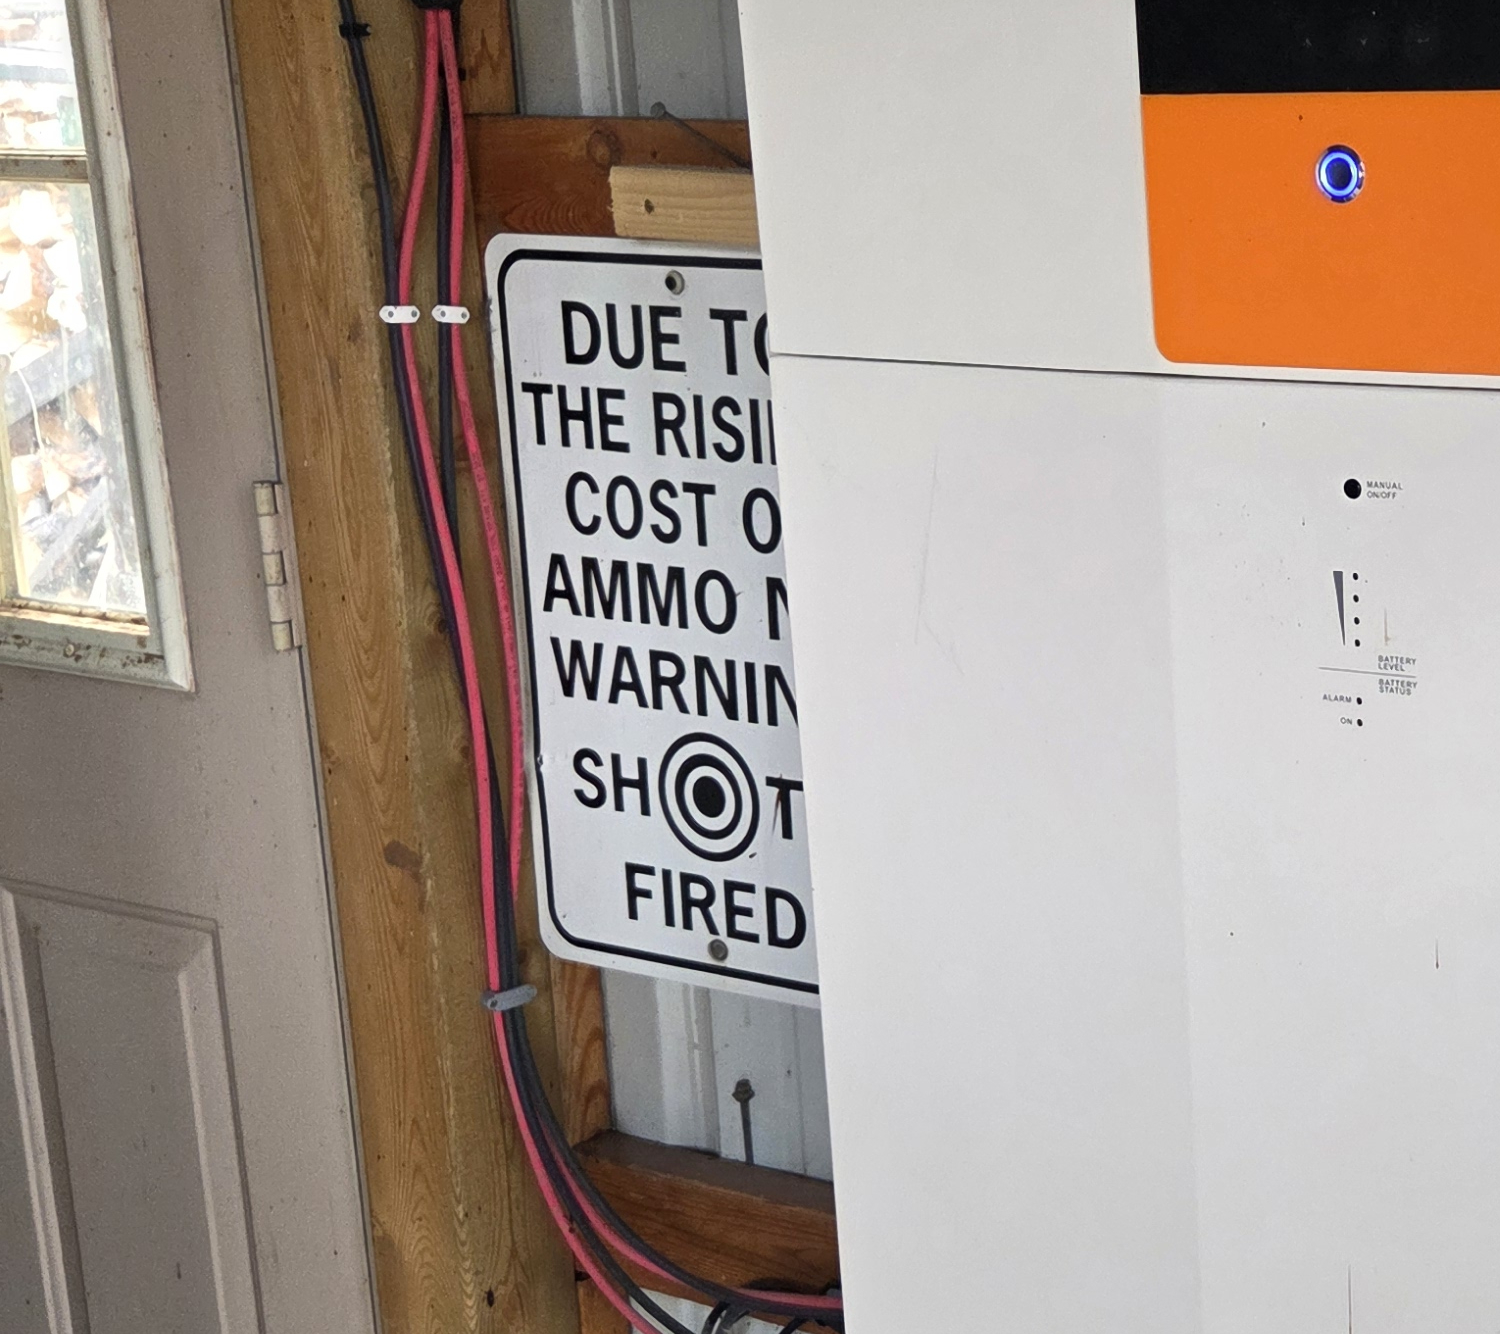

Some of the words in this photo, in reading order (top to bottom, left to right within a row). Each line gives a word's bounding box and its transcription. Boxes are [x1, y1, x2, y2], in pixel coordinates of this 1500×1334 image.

[561, 300, 686, 373] DUE
[522, 382, 630, 453] THE
[1366, 480, 1403, 490] MANUAL
[1366, 490, 1397, 500] ON/OFF
[565, 471, 716, 547] COST
[543, 553, 737, 636] AMMO
[1377, 654, 1416, 666] BATTERY
[1378, 662, 1405, 672] LEVEL
[1378, 678, 1417, 689] BATTERY
[1379, 686, 1411, 696] STATUS
[1322, 693, 1352, 703] ALARM
[1340, 716, 1353, 726] ON
[624, 862, 806, 951] FIRED
